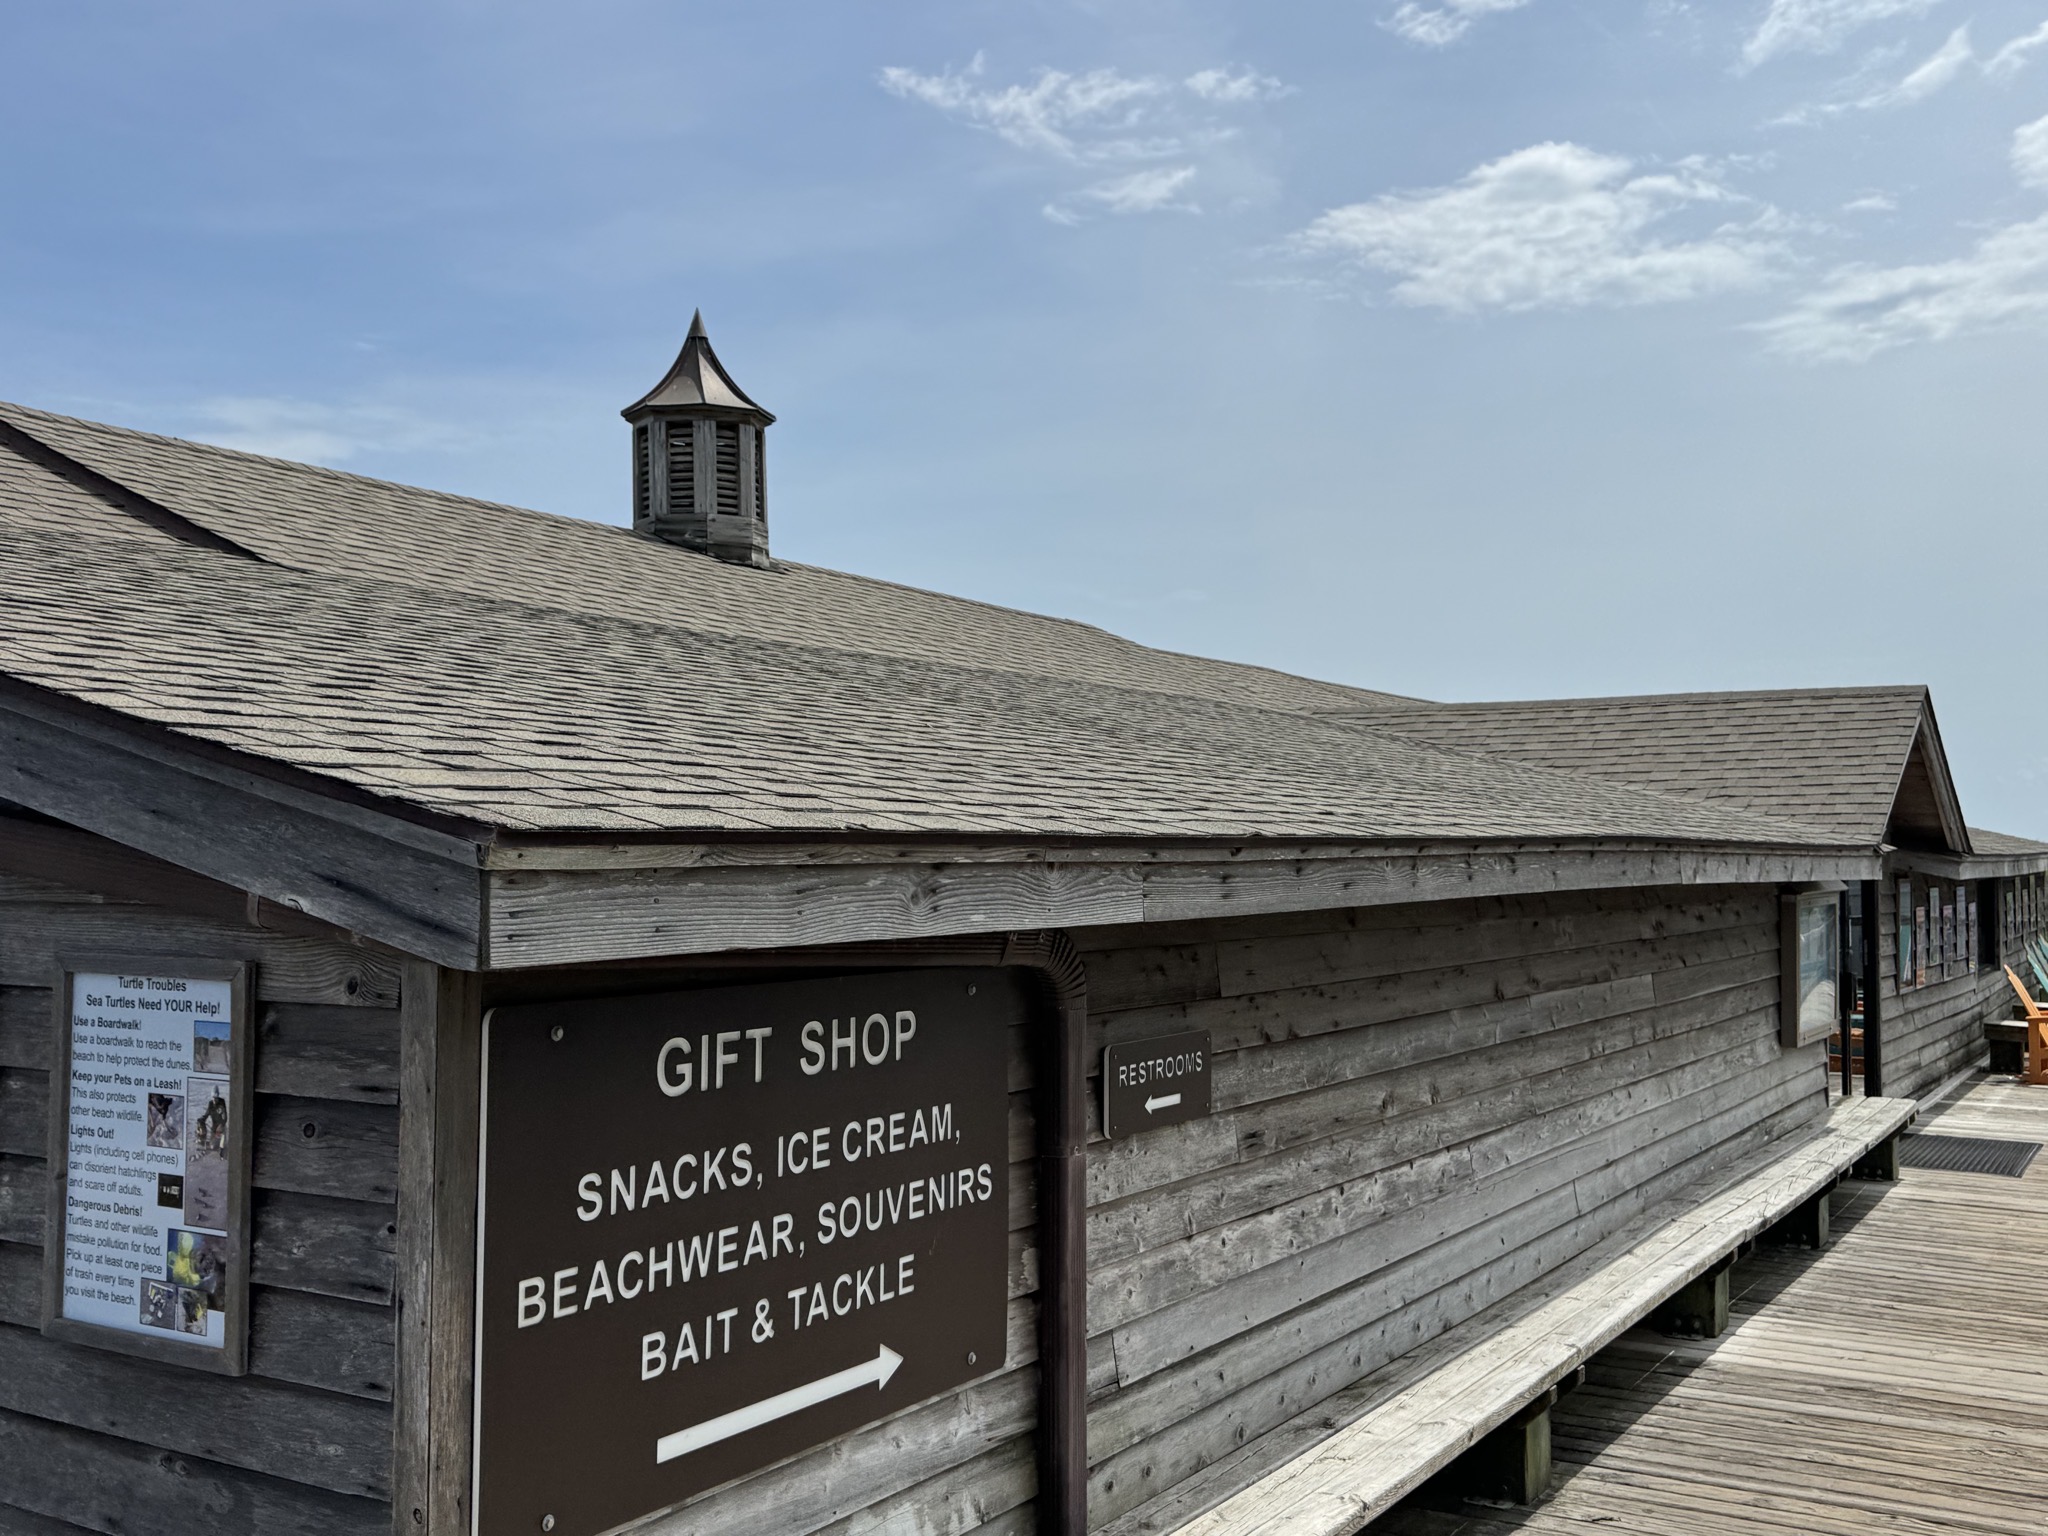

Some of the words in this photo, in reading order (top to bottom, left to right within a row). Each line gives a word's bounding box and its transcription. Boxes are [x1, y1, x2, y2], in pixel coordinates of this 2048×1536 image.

[118, 977, 143, 989] Turtle
[146, 978, 187, 992] Troubles
[86, 995, 102, 1006] Sea
[105, 996, 135, 1008] Turtles
[138, 998, 161, 1010] Need
[165, 999, 192, 1012] YOUR
[195, 1001, 220, 1016] Help!
[74, 1015, 88, 1026] Use
[91, 1019, 95, 1027] a
[98, 1017, 142, 1030] Boardwalk!
[73, 1033, 87, 1043] Use
[97, 1034, 134, 1047] boardwalk
[136, 1039, 143, 1048] to
[146, 1039, 167, 1050] reach
[170, 1041, 181, 1051] the
[73, 1051, 95, 1062] beach
[97, 1053, 104, 1063] to
[106, 1054, 122, 1066] help
[124, 1055, 150, 1067] protect
[152, 1057, 163, 1068] the
[657, 1027, 772, 1098] GIFT
[800, 1011, 917, 1076] SHOP
[1119, 1051, 1204, 1088] RESTROOMS
[72, 1070, 92, 1083] Keep
[94, 1074, 112, 1086] your
[114, 1074, 131, 1085] Pets
[134, 1078, 144, 1086] on
[147, 1079, 151, 1087] a
[154, 1078, 181, 1090] Leash!
[72, 1087, 87, 1098] This
[89, 1089, 104, 1100] also
[106, 1092, 136, 1103] protects
[71, 1106, 90, 1116] other
[92, 1107, 114, 1119] beach
[71, 1125, 94, 1138] Lights
[98, 1127, 114, 1139] Out!
[70, 1142, 92, 1154] Lights
[132, 1150, 144, 1161] cell
[147, 1152, 178, 1167] phones)
[577, 1141, 763, 1221] SNACKS,
[777, 1126, 831, 1178] ICE
[842, 1103, 961, 1162] CREAM,
[70, 1161, 83, 1170] can
[118, 1166, 156, 1181] hatchlings
[69, 1177, 82, 1188] and
[85, 1180, 104, 1190] scare
[107, 1181, 117, 1192] off
[69, 1196, 111, 1213] Dangerous
[114, 1203, 142, 1216] Debris!
[68, 1214, 92, 1227] Turtles
[94, 1219, 108, 1230] and
[110, 1221, 130, 1233] other
[132, 1224, 158, 1237] wildlife
[67, 1233, 95, 1245] mistake
[97, 1237, 128, 1249] pollution
[131, 1240, 141, 1252] for
[518, 1214, 805, 1329] BEACHWEAR,
[817, 1164, 993, 1244] SOUVENIRS
[66, 1249, 81, 1259] Pick
[84, 1254, 93, 1263] up
[95, 1254, 102, 1263] at
[105, 1254, 123, 1267] least
[125, 1261, 139, 1270] one
[141, 1262, 162, 1274] piece
[65, 1267, 73, 1276] of
[75, 1268, 93, 1280] trash
[95, 1275, 115, 1286] every
[118, 1276, 134, 1287] time
[65, 1286, 79, 1296] you
[81, 1286, 95, 1298] visit
[97, 1288, 109, 1300] the
[641, 1308, 738, 1381] BAIT
[752, 1298, 774, 1344] &
[788, 1255, 915, 1331] TACKLE
